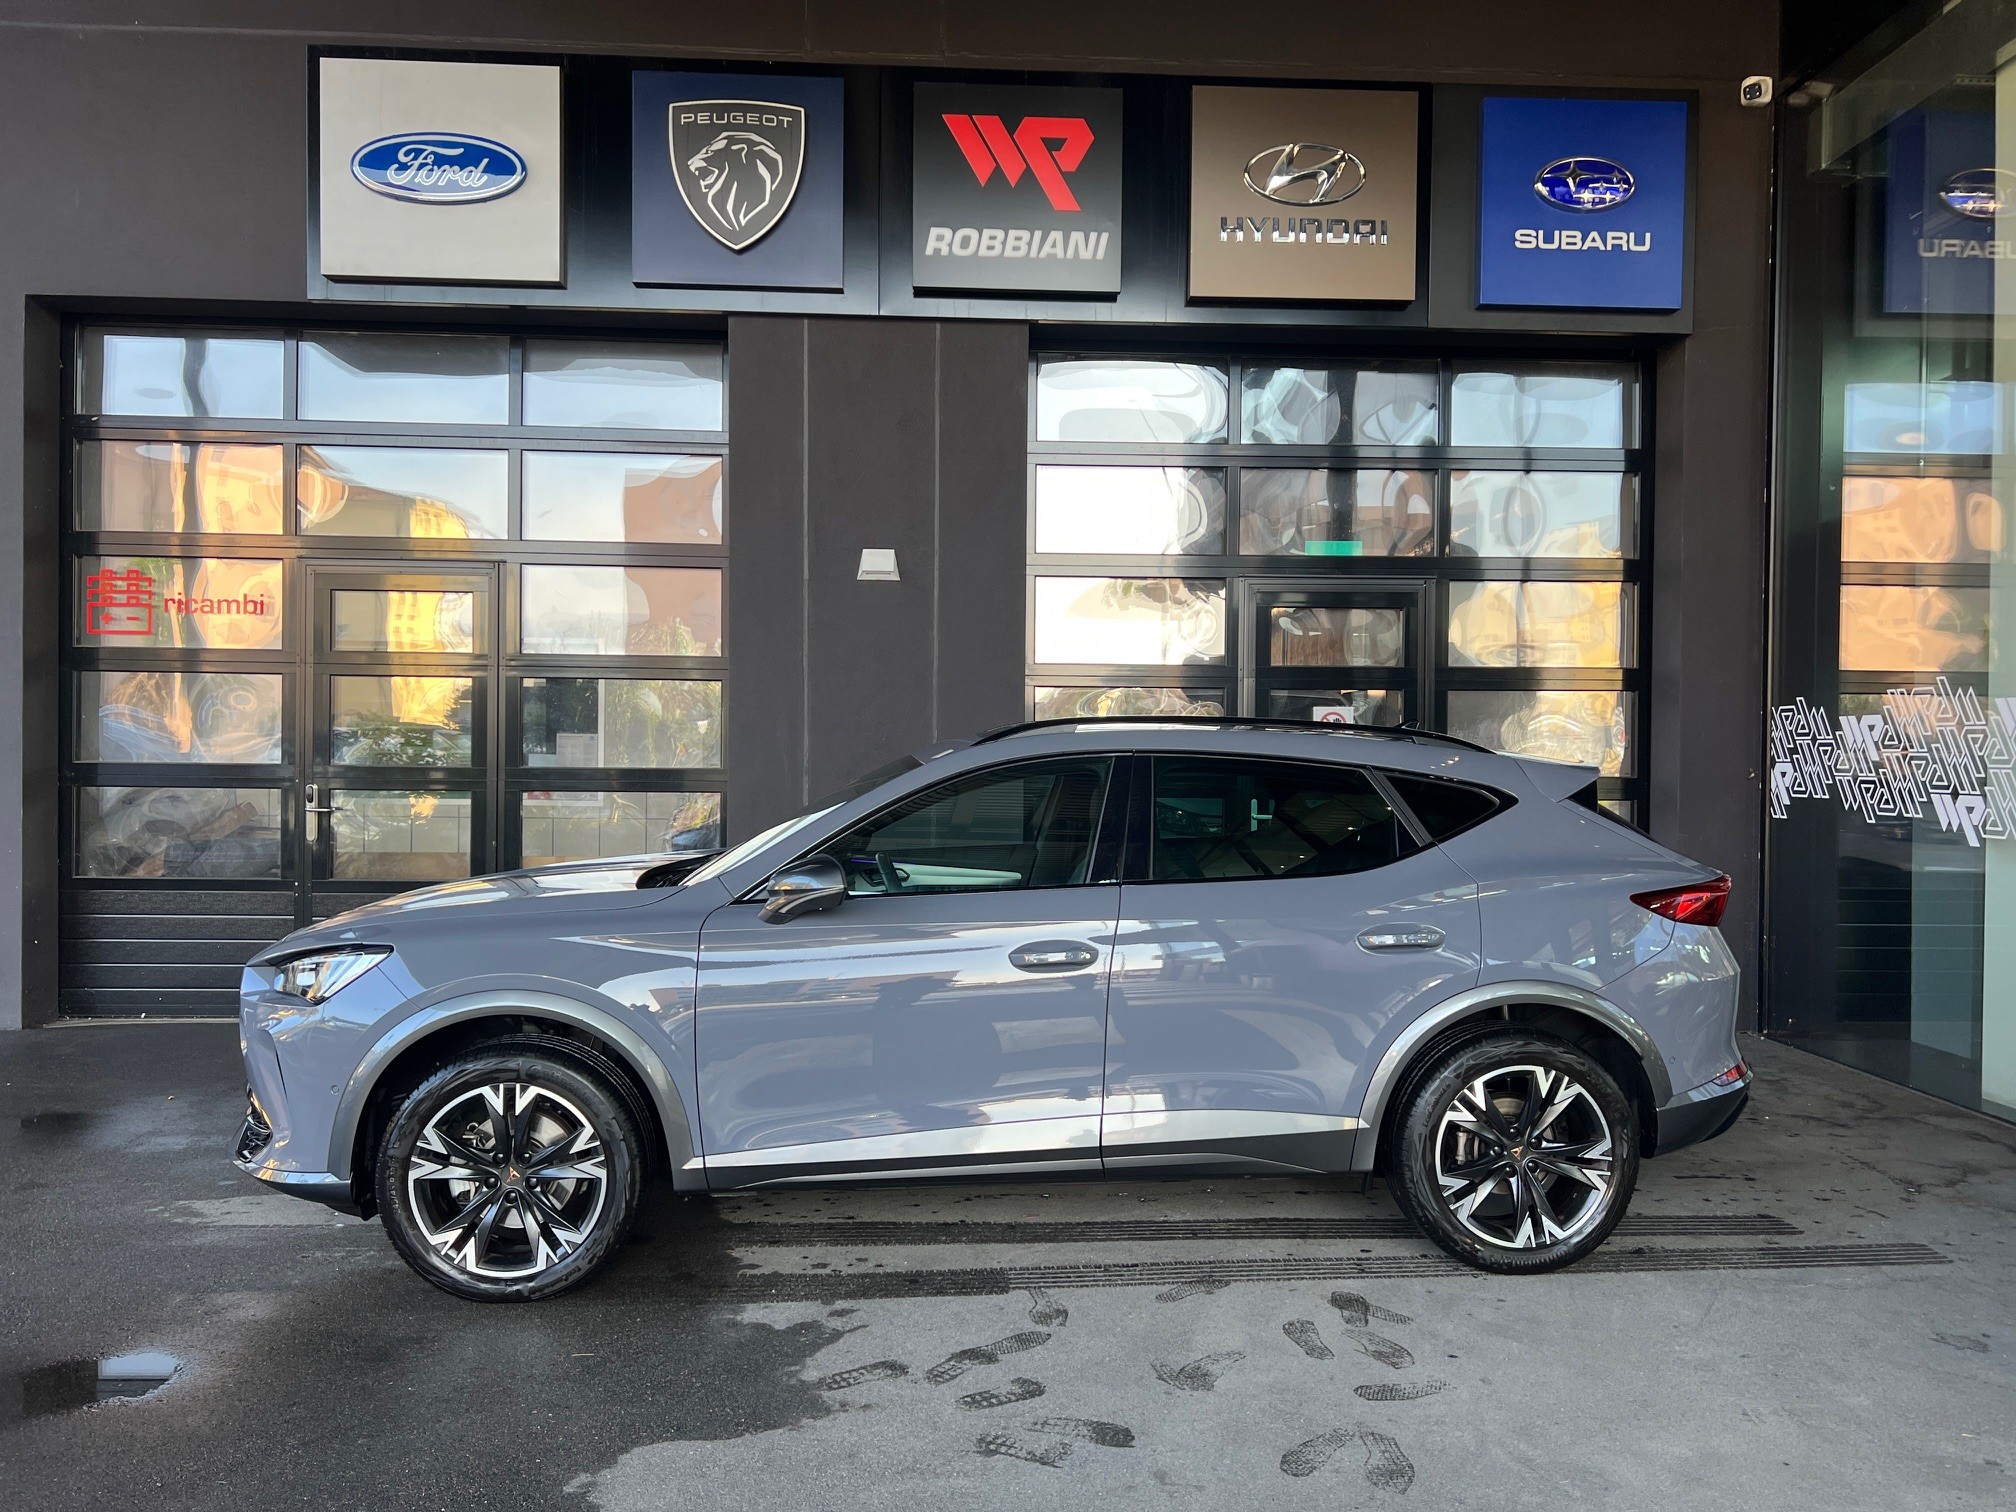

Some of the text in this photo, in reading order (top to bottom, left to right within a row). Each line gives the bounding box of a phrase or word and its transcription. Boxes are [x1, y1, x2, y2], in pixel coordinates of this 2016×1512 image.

[680, 111, 794, 129] PEUGEOT
[386, 143, 491, 188] Ford
[925, 226, 1109, 260] ROBBIANI
[1219, 216, 1389, 246] HYUNDAI
[1514, 229, 1652, 252] SUBARU
[163, 592, 265, 615] ricambi
